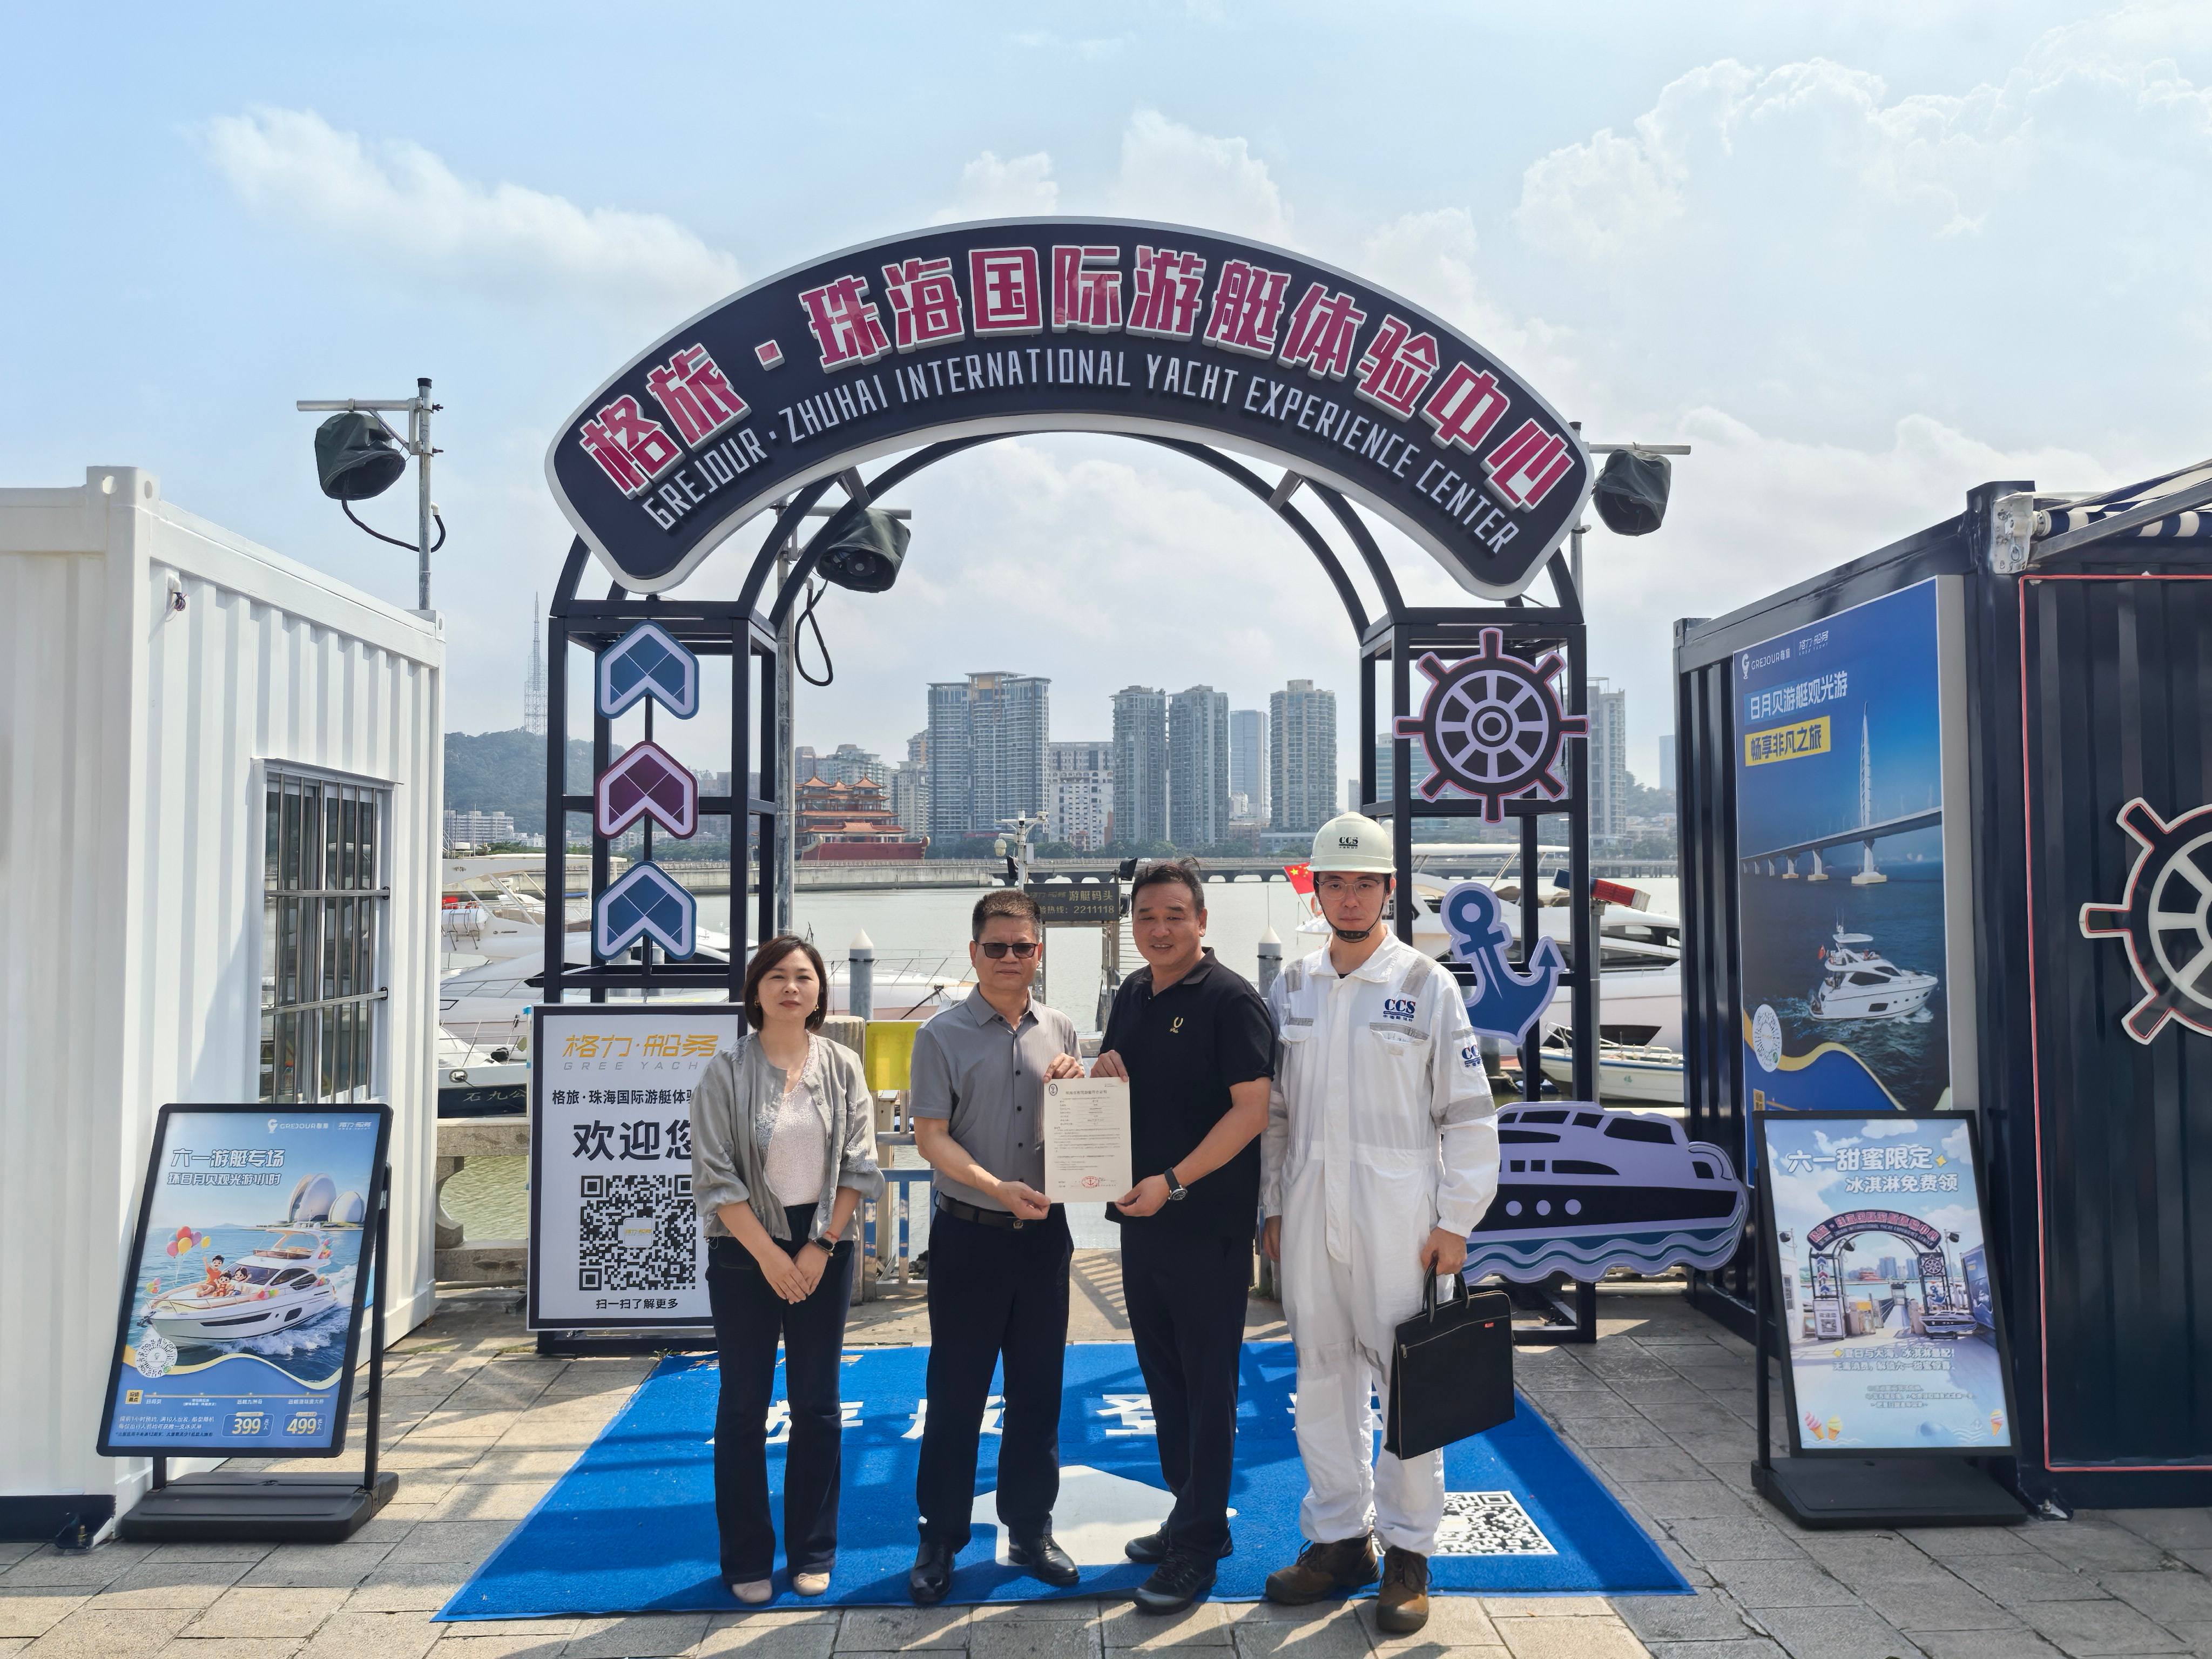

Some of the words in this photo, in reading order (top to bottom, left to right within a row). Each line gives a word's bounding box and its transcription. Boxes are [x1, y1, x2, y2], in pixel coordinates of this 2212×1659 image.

[895, 348, 1131, 403] INTERNATIONAL
[1146, 354, 1239, 404] YACHT
[1244, 376, 1420, 478] EXPERIENCE
[1415, 460, 1519, 554] CENTER
[1750, 670, 1848, 720] 日月贝游艇观光游
[1751, 724, 1822, 761] 畅享非凡之旅
[1069, 891, 1113, 901] 游艇码头
[1074, 906, 1115, 914] 2211118
[1385, 999, 1416, 1014] CCS
[562, 1034, 719, 1058] 格力·船务
[1462, 1044, 1480, 1060] CC
[564, 1062, 623, 1070] GREE
[641, 1062, 698, 1070] YACH
[572, 1120, 692, 1161] 欢迎您
[171, 1148, 285, 1168] 六一游艇专场
[1788, 1146, 1933, 1173] 六一甜蜜限定
[1845, 1173, 1958, 1193] 冰淇淋免费领
[596, 1298, 678, 1309] 扫一扫了解更多
[232, 1418, 261, 1434] 399
[287, 1418, 316, 1434] 499
